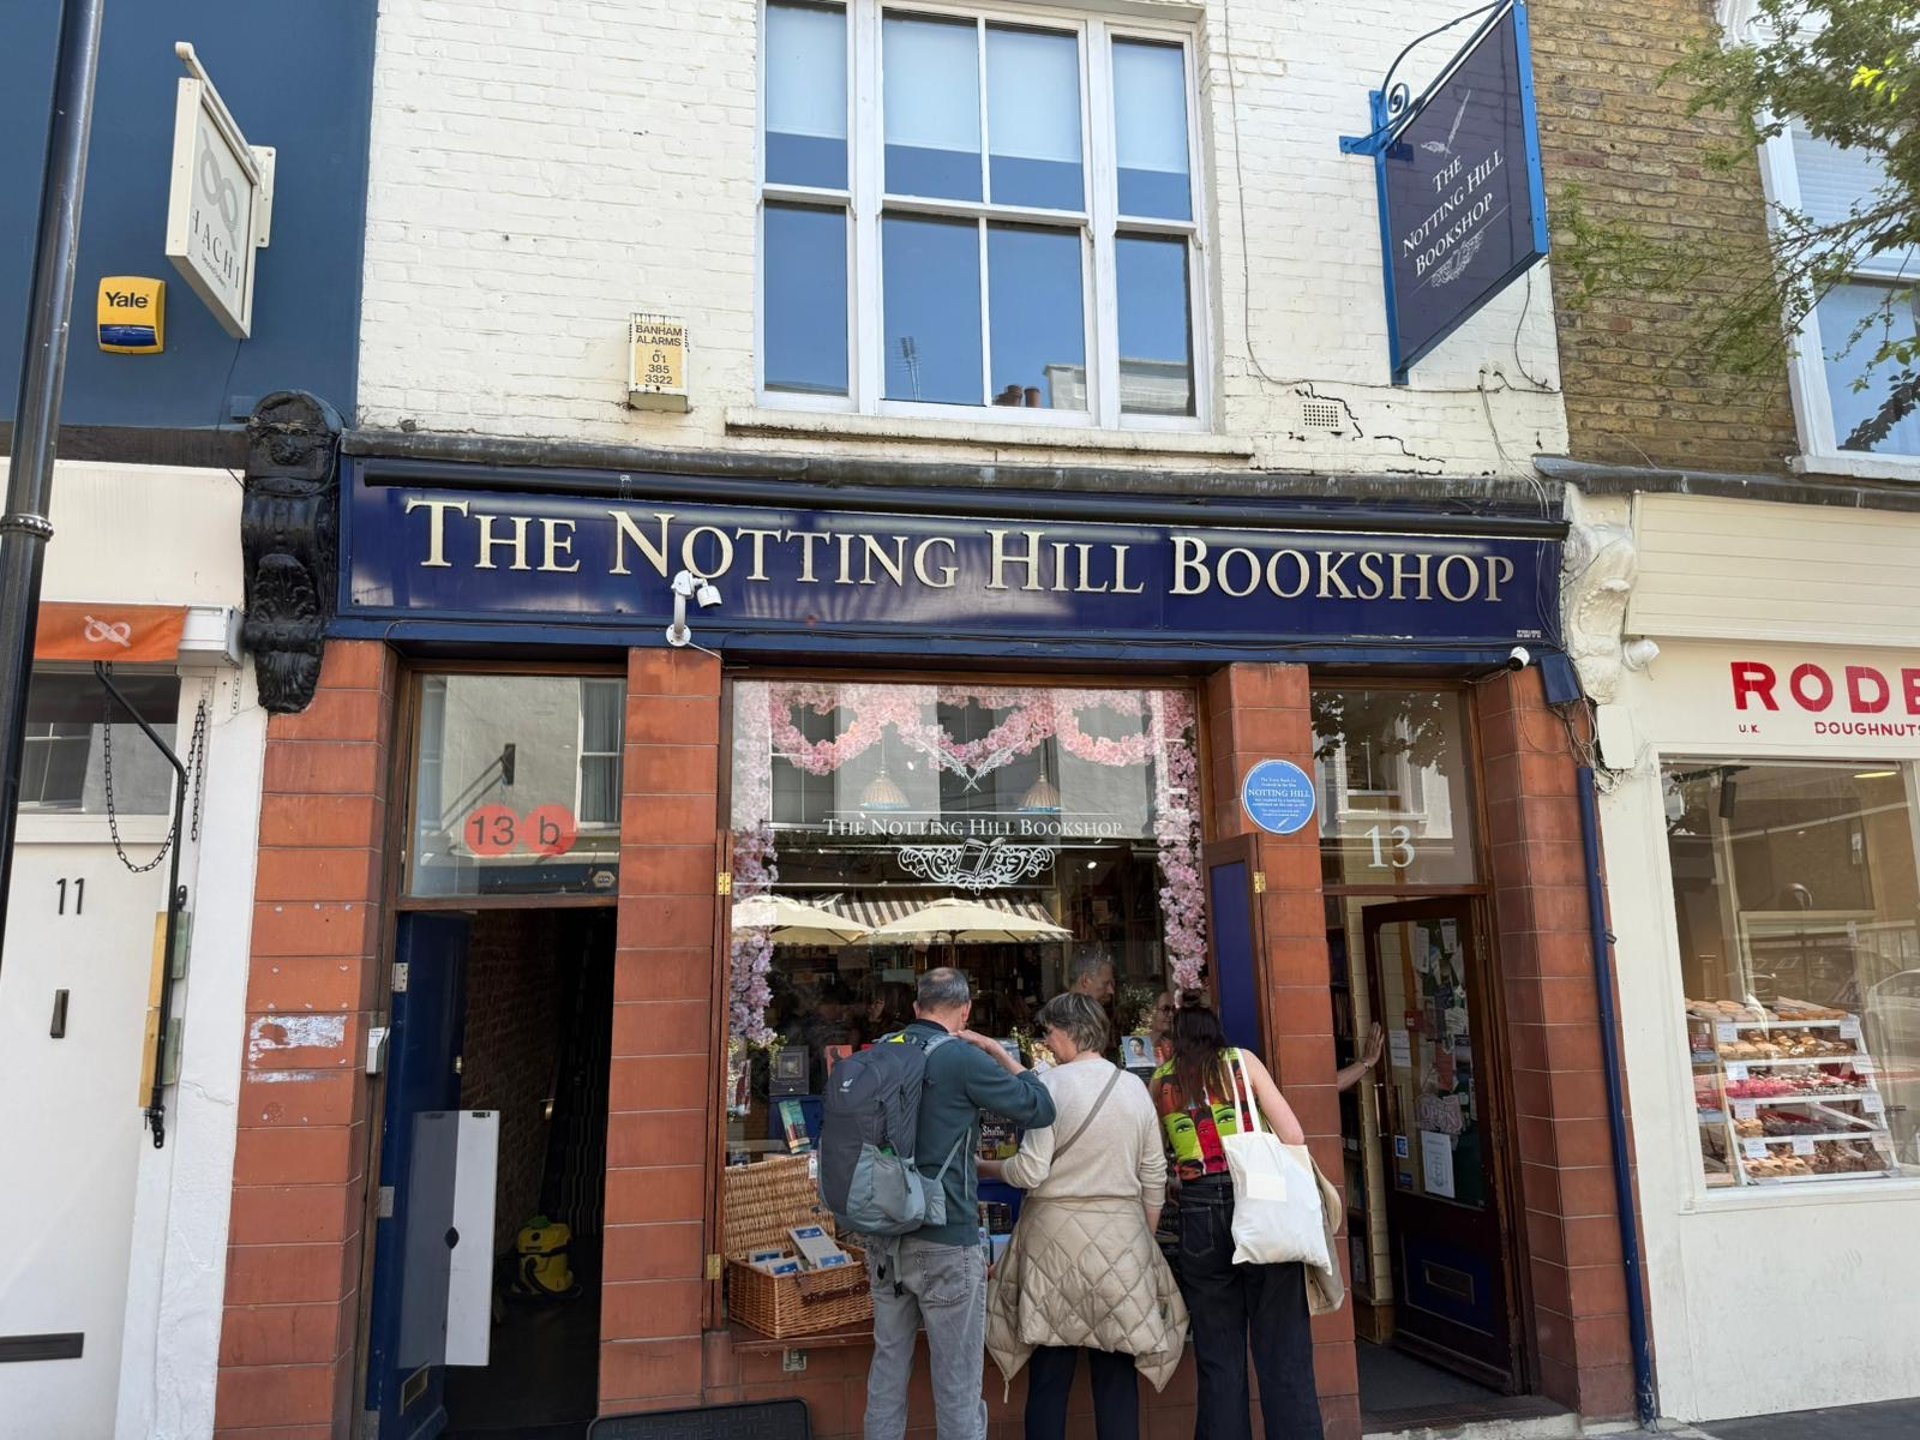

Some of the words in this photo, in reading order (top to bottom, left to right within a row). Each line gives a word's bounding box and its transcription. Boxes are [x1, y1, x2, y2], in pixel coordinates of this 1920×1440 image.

[1432, 155, 1463, 193] THE
[1403, 187, 1464, 257] NOTTING
[1467, 150, 1504, 194] HILL
[1415, 192, 1493, 277] BOOKSHOP
[105, 291, 149, 309] Yale
[635, 325, 682, 336] BANHAM
[636, 335, 682, 347] ALARMS
[652, 353, 667, 364] 01
[648, 364, 670, 374] 385
[645, 374, 673, 385] 3322
[404, 498, 581, 573] THE
[608, 510, 959, 588] NOTTING
[985, 528, 1145, 595] HILL
[1169, 535, 1515, 602] BOOKSHOP
[1814, 721, 1920, 737] DOUGHNUT
[1248, 788, 1288, 798] NOTTING
[1290, 789, 1311, 798] HILL
[471, 815, 515, 846] 13
[539, 815, 560, 846] b
[823, 818, 868, 836] THE
[870, 818, 964, 836] NOTTING
[969, 819, 1017, 836] HILL
[1020, 818, 1122, 836] BOOKSHOP
[1364, 825, 1415, 868] 13
[56, 877, 85, 916] 11
